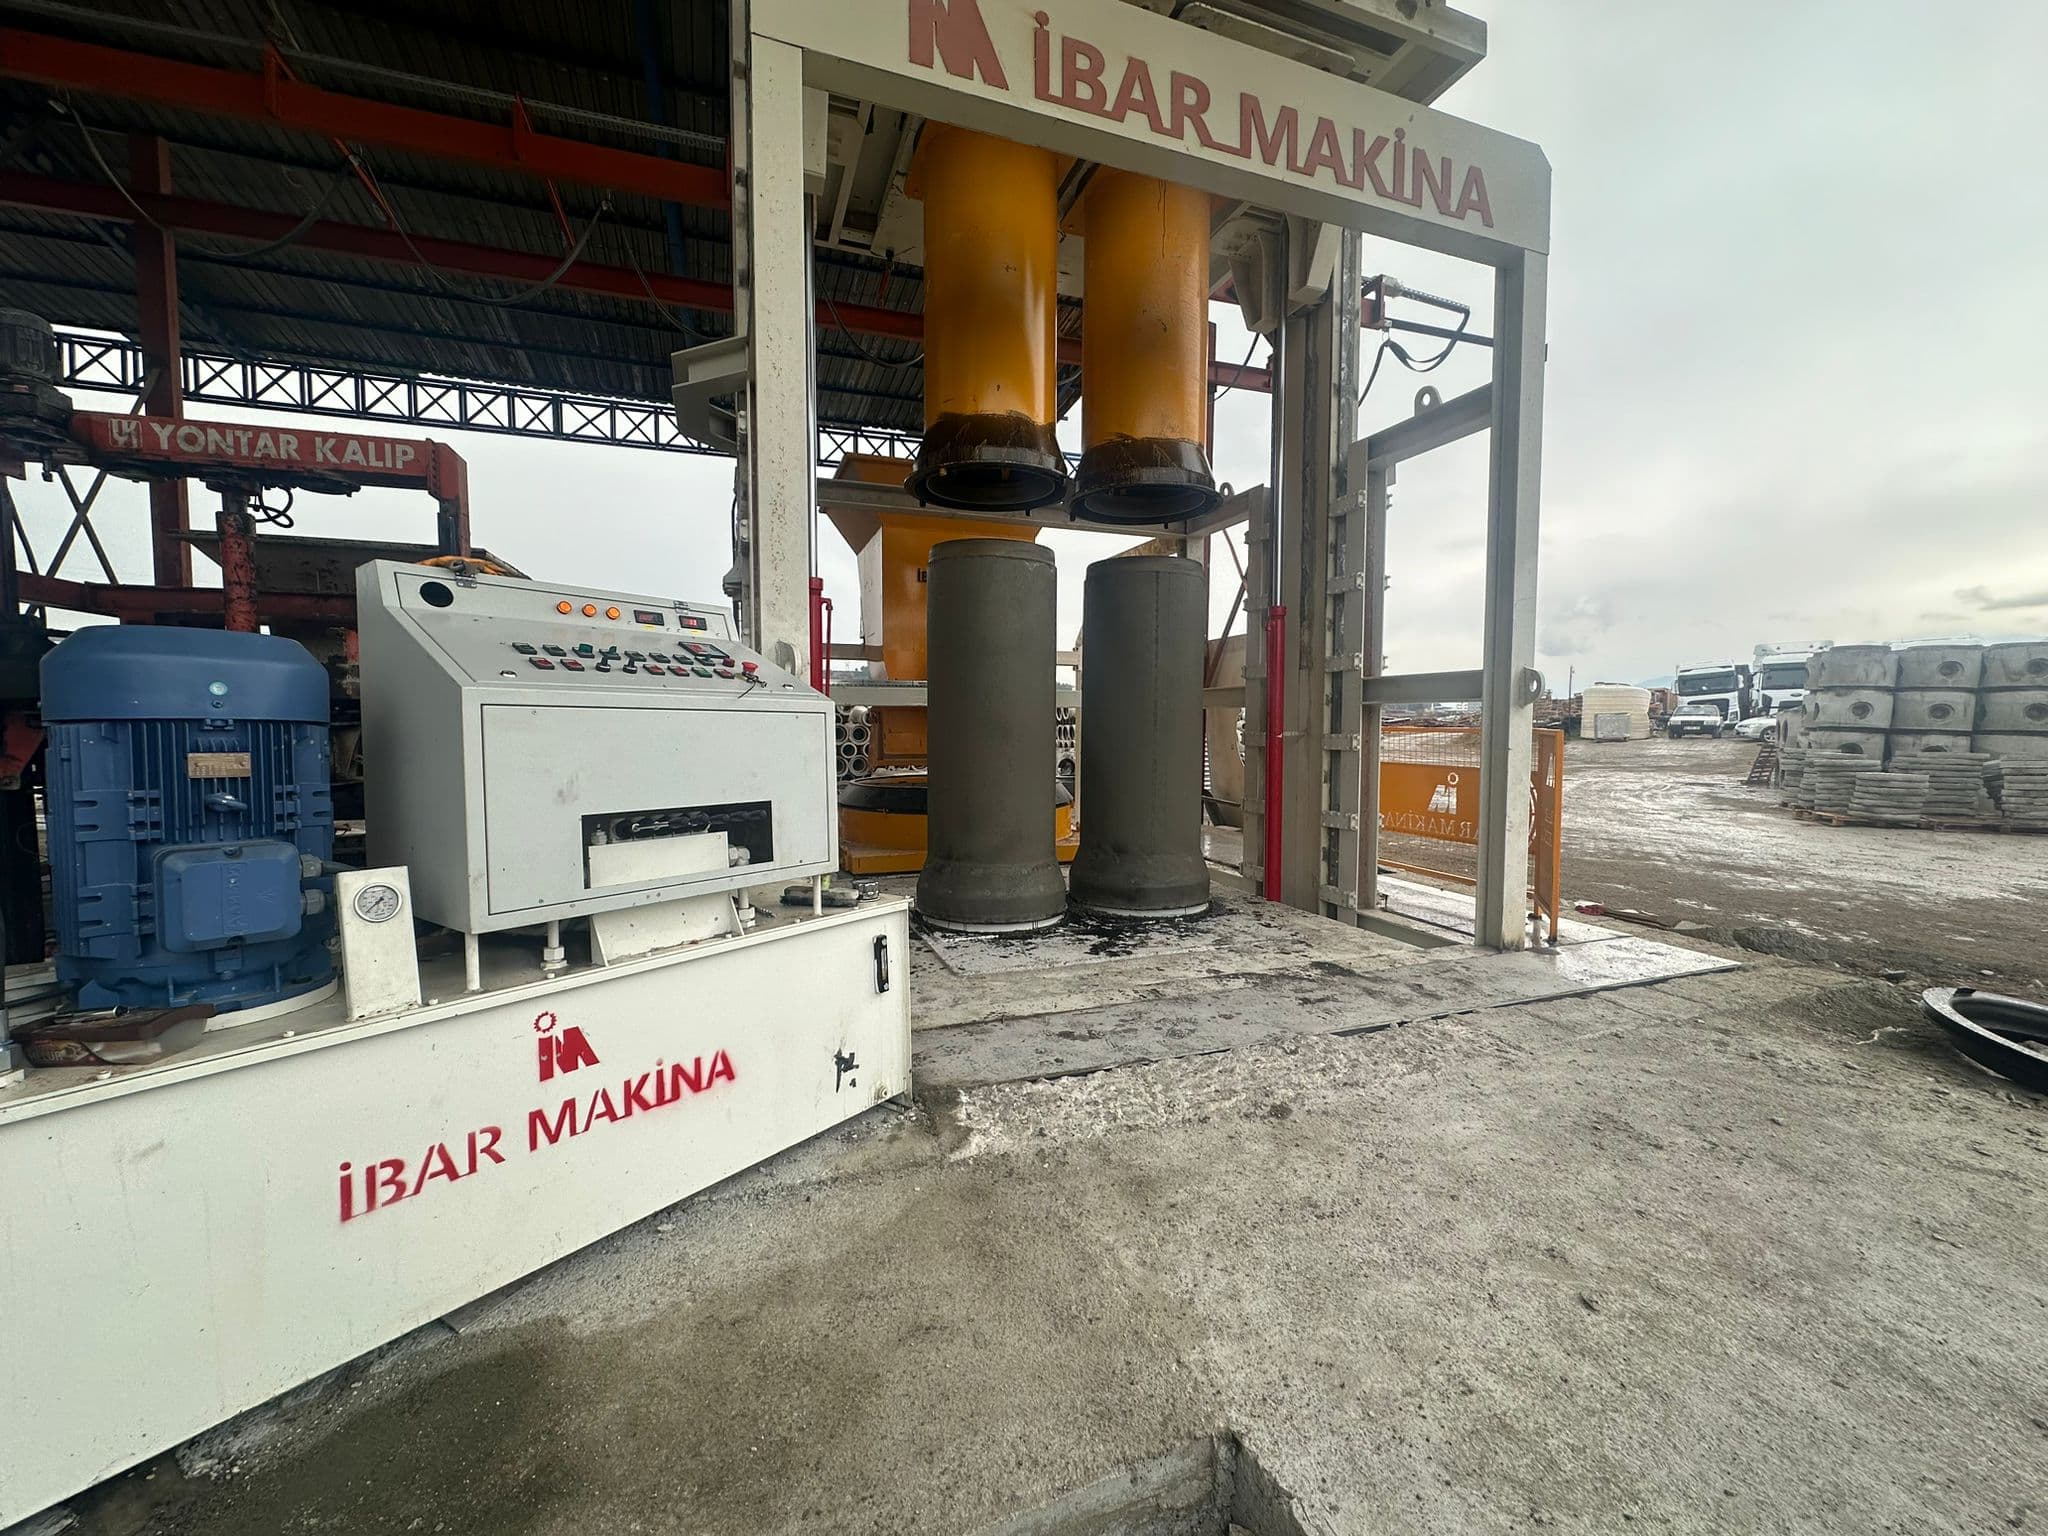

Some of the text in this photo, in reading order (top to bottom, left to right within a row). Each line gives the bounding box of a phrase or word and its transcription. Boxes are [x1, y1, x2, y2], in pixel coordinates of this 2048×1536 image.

[1238, 91, 1495, 229] MAKİNA
[150, 422, 301, 460] YONTAR
[316, 437, 416, 469] KALIP
[338, 1048, 737, 1223] İBAR MAKİNA
